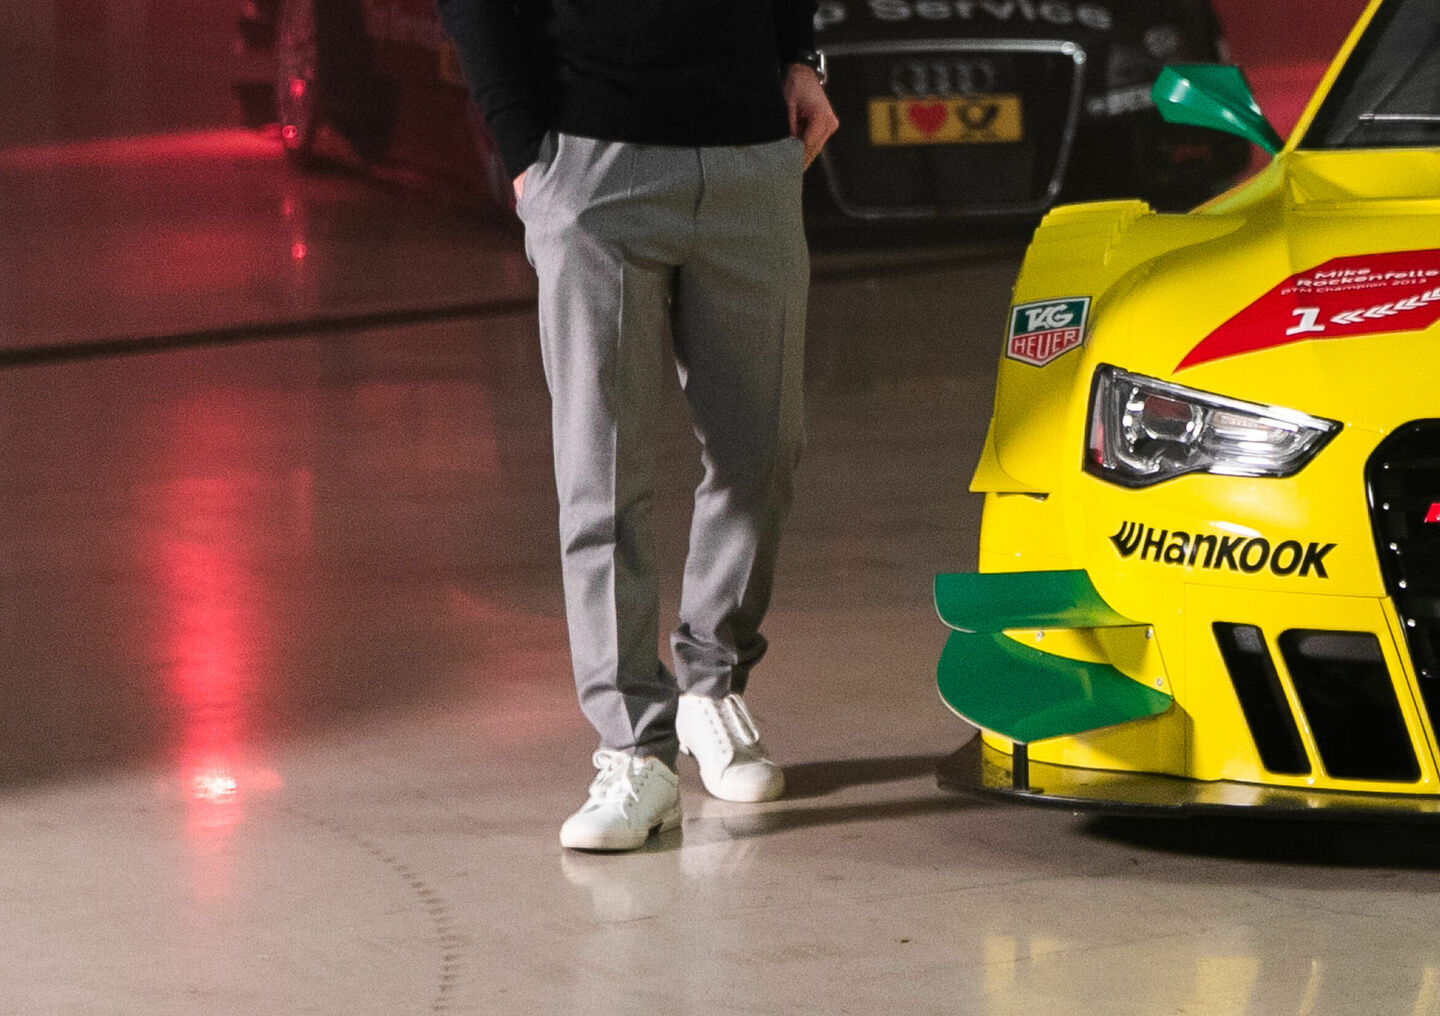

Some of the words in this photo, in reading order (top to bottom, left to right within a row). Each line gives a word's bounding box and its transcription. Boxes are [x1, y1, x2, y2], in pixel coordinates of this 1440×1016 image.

[1314, 268, 1371, 280] Mike
[1025, 304, 1074, 332] TAG
[1285, 307, 1326, 336] 1
[1013, 330, 1077, 360] HEUER
